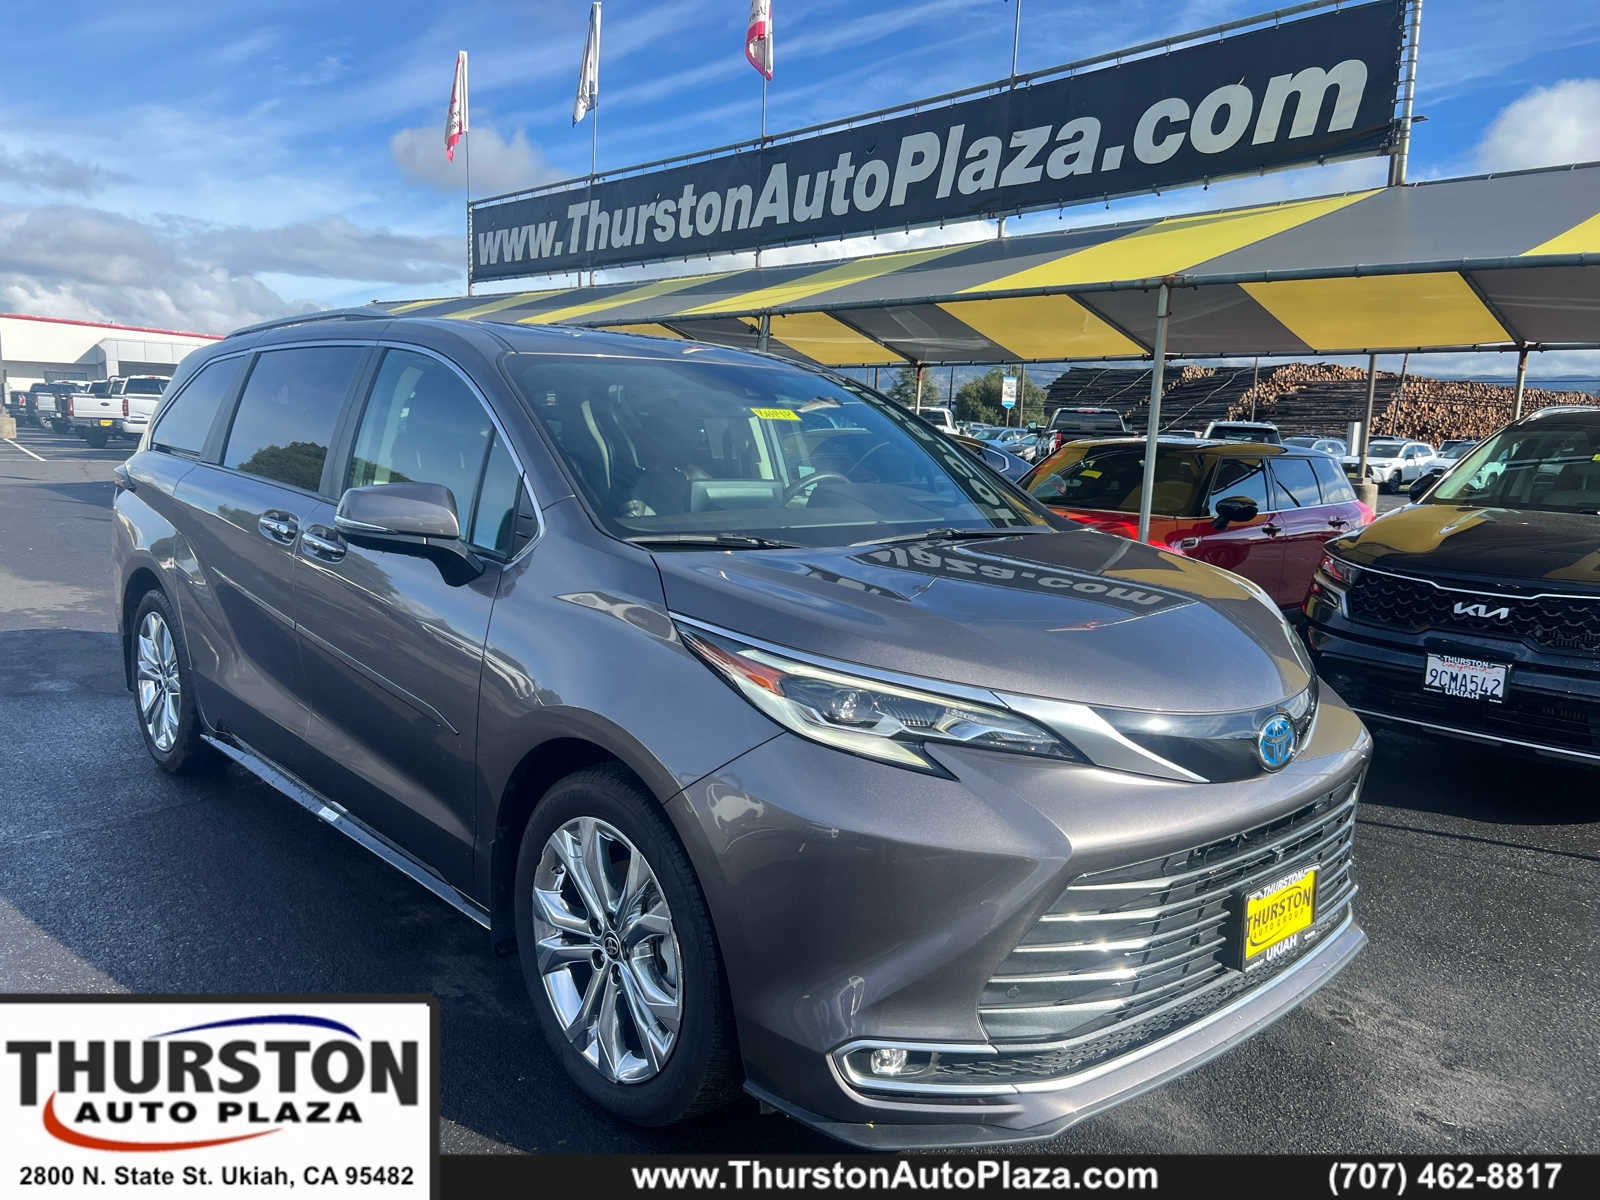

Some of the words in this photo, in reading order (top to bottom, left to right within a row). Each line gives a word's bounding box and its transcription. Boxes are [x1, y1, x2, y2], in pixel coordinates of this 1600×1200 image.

[478, 58, 1368, 266] www.ThurstonAutoPlaza.com
[1443, 656, 1489, 668] THURSTON
[1428, 668, 1501, 696] 9CMA542
[1445, 688, 1480, 700] UKIAH
[1263, 868, 1306, 897] THURSTON
[1246, 886, 1312, 938] THURSTON
[1266, 933, 1298, 961] UKIAH
